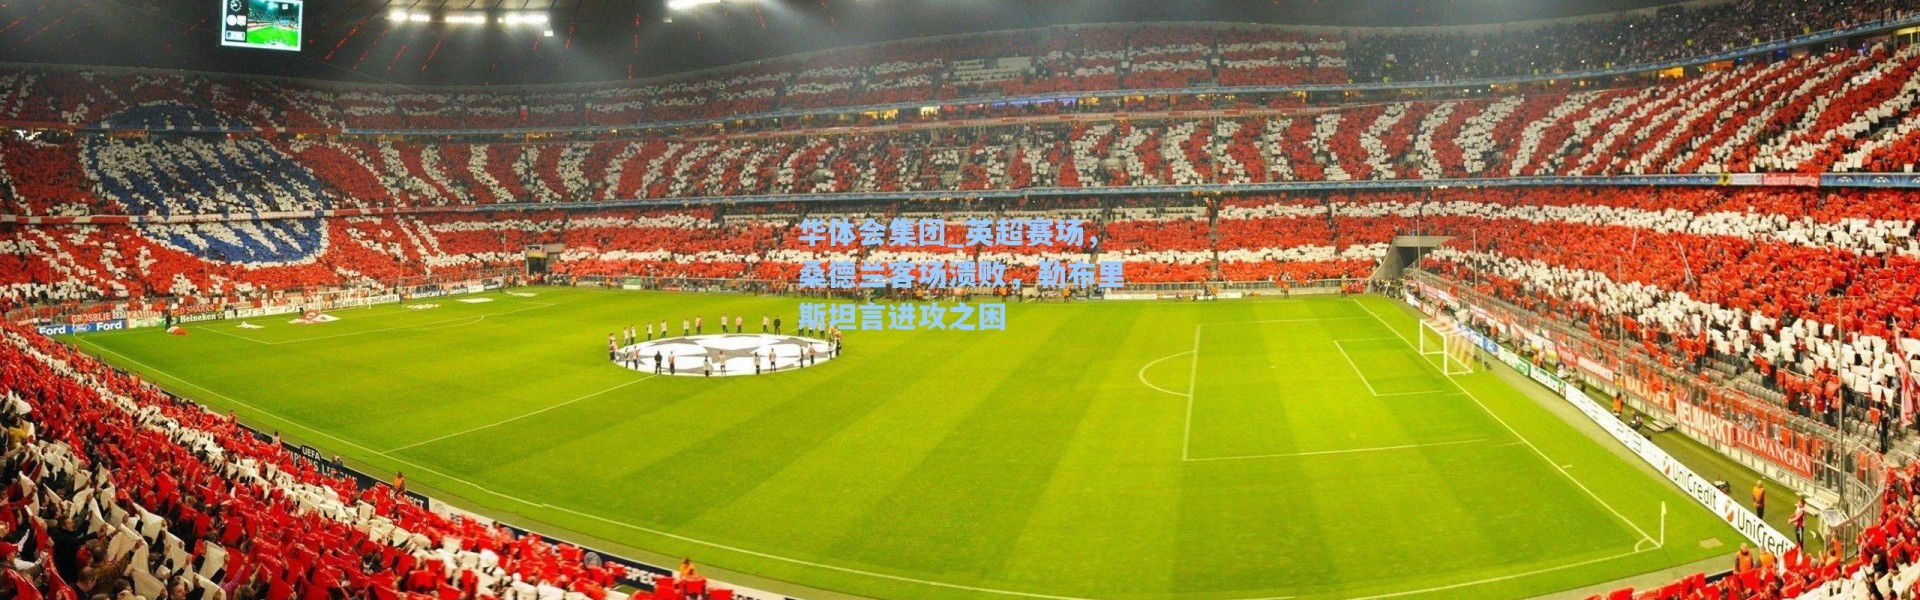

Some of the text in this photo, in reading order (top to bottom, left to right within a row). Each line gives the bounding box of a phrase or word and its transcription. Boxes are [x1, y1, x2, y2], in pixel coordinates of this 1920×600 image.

[186, 303, 216, 314] SHARKS
[180, 312, 217, 323] Heineken
[38, 326, 66, 336] Ford
[96, 320, 122, 331] Ford
[1676, 399, 1733, 446] NEUMARKT
[302, 446, 321, 461] UEFA
[1737, 428, 1812, 474] ELLWANGEN
[1672, 461, 1718, 510] UniCredit
